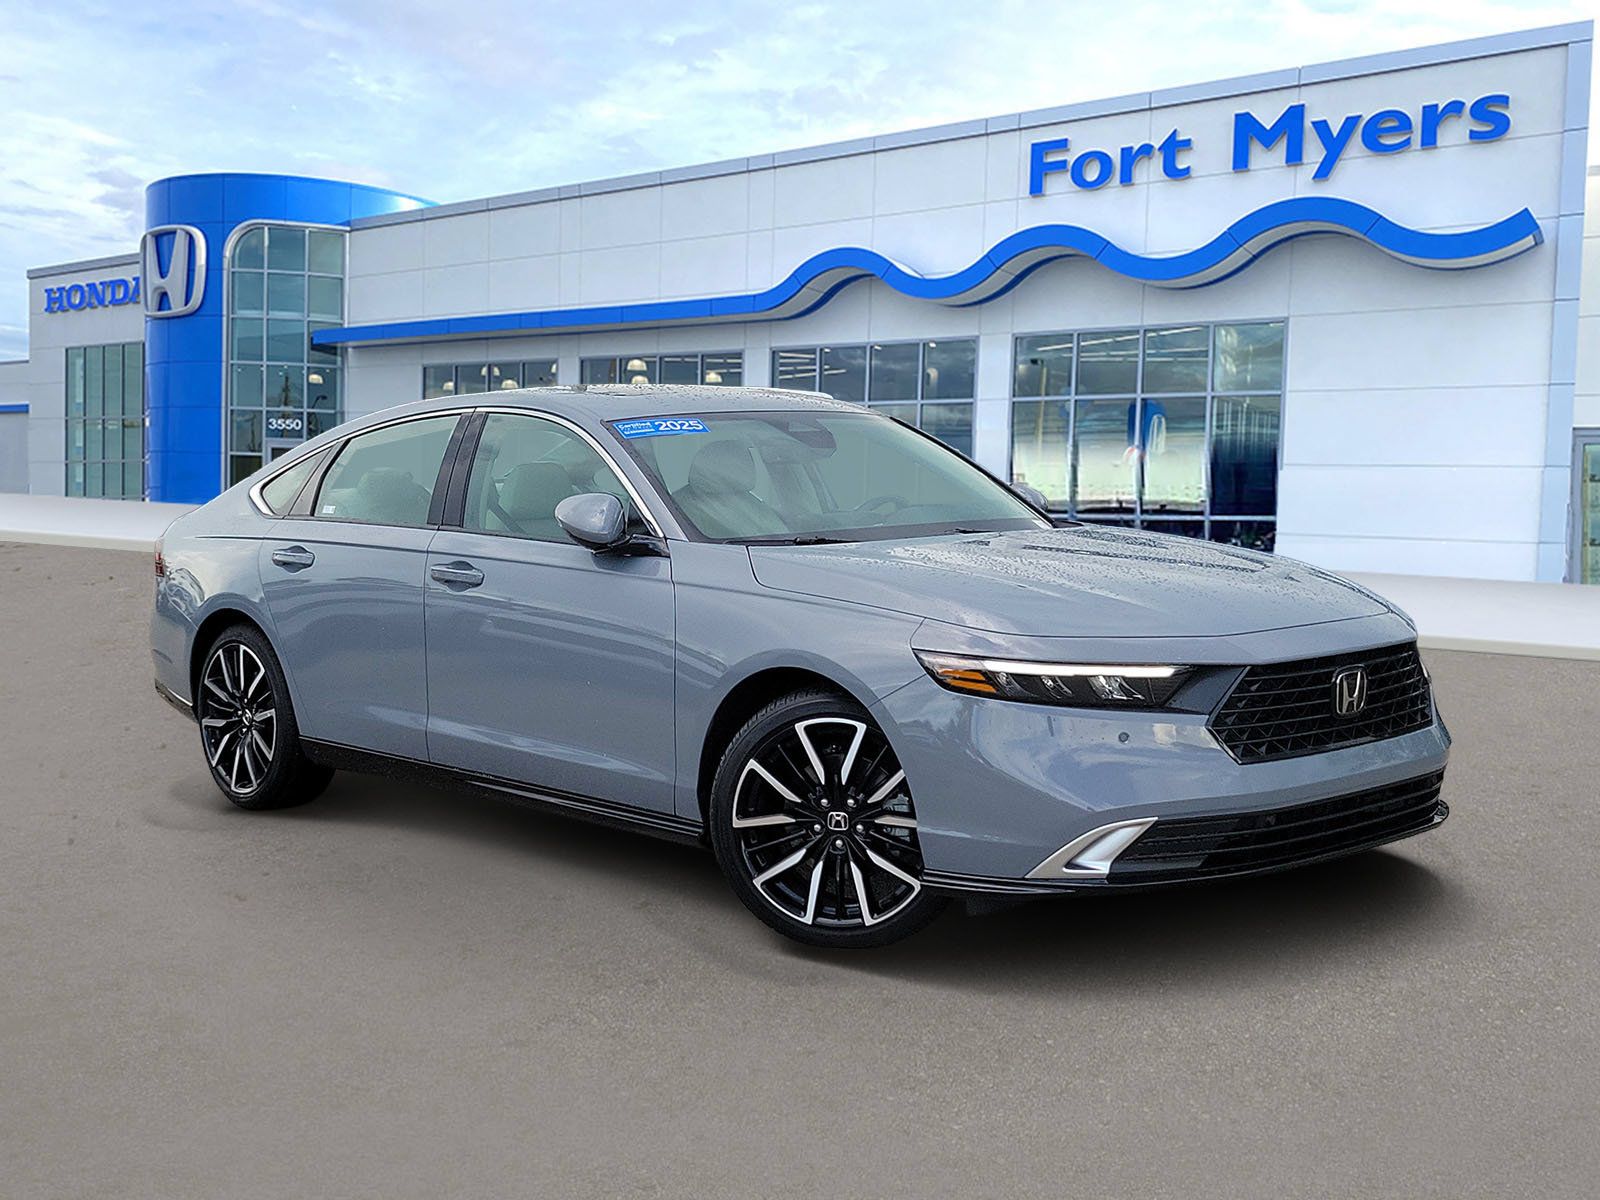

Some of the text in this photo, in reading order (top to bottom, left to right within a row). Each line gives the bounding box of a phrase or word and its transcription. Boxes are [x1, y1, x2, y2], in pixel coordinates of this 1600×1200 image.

[1029, 94, 1512, 196] Fort Myers
[268, 418, 302, 430] 3550
[654, 420, 704, 431] 2025
